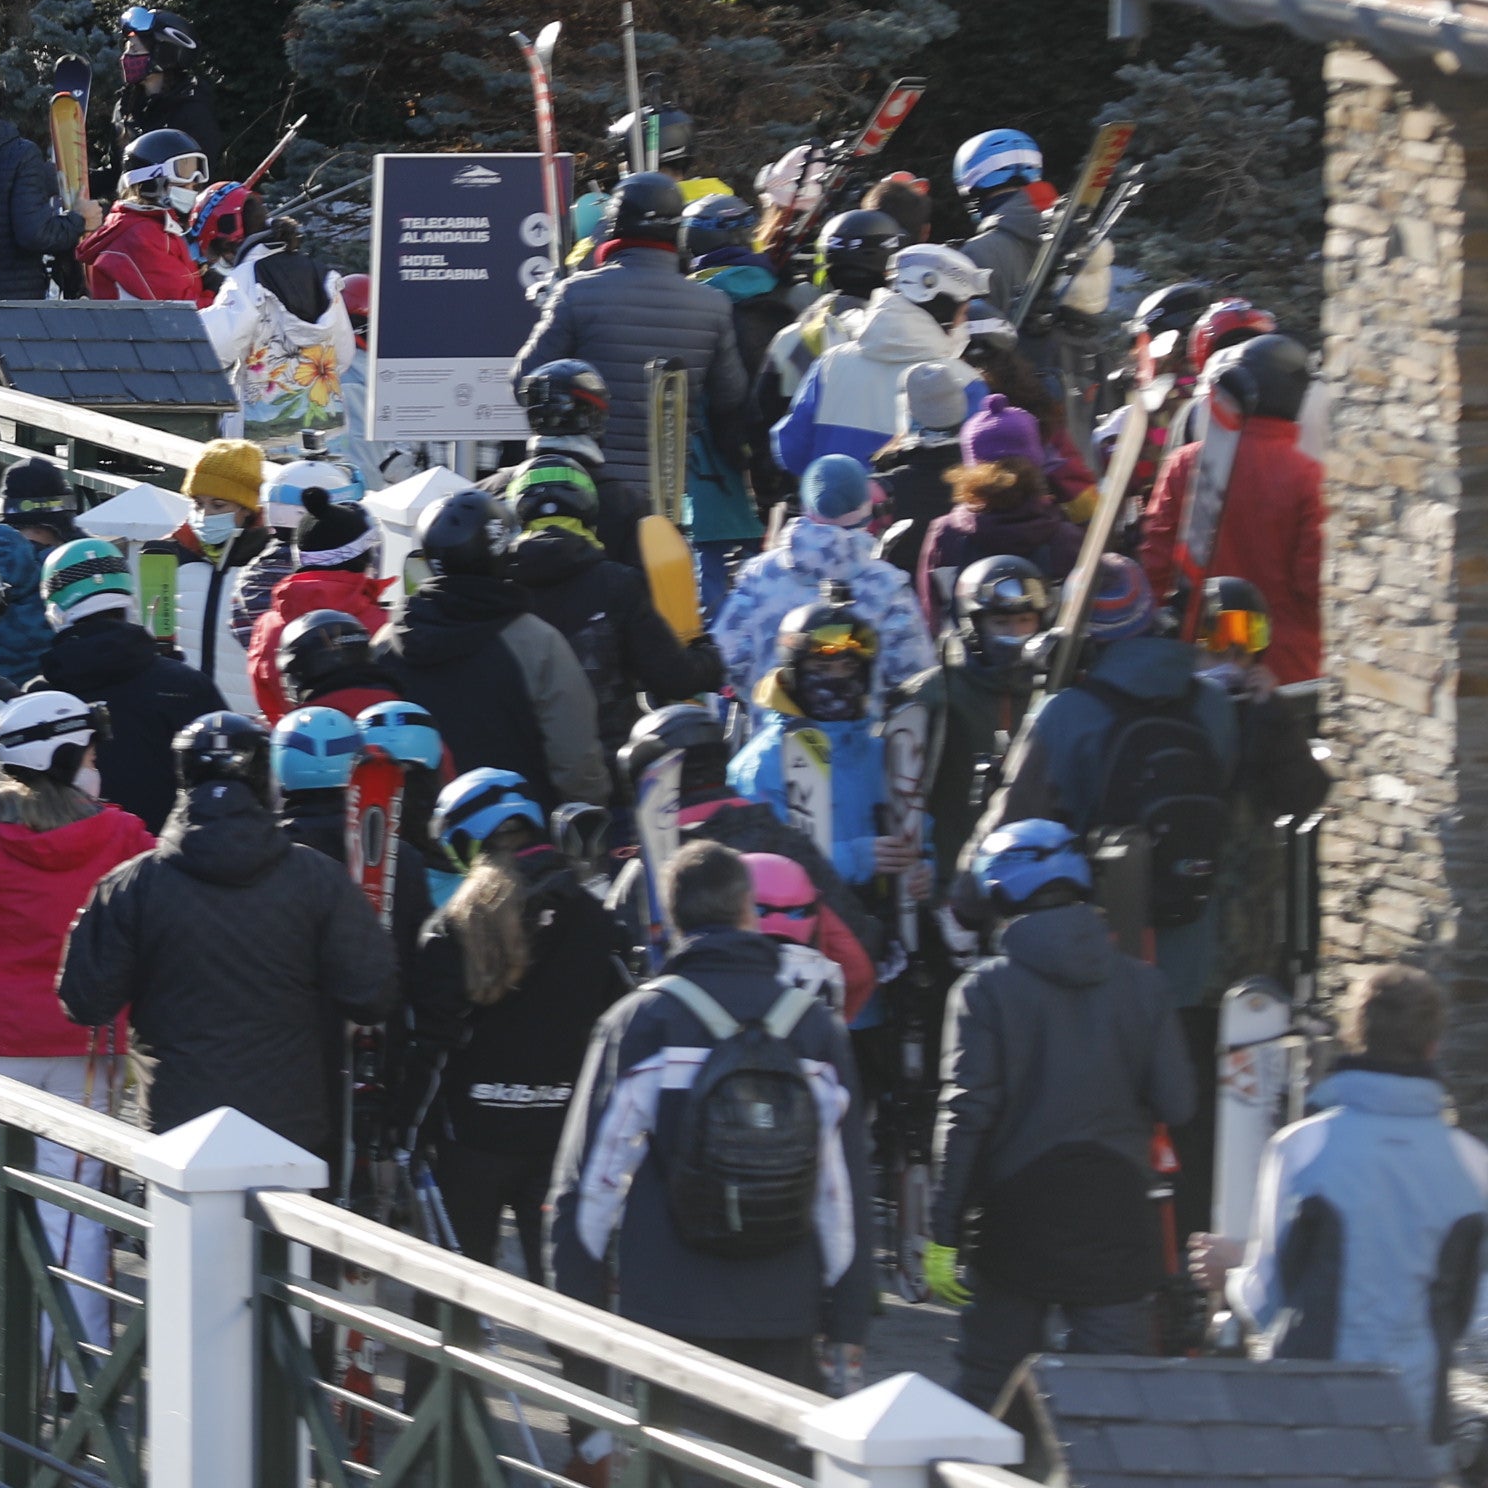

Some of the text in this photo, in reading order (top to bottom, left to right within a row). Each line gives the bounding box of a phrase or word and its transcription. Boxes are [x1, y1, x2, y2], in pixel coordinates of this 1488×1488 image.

[399, 217, 491, 230] TELECABINA
[398, 231, 491, 244] AL ANDALUS
[399, 254, 449, 267] HOTEL
[398, 268, 489, 281] TELECABINA
